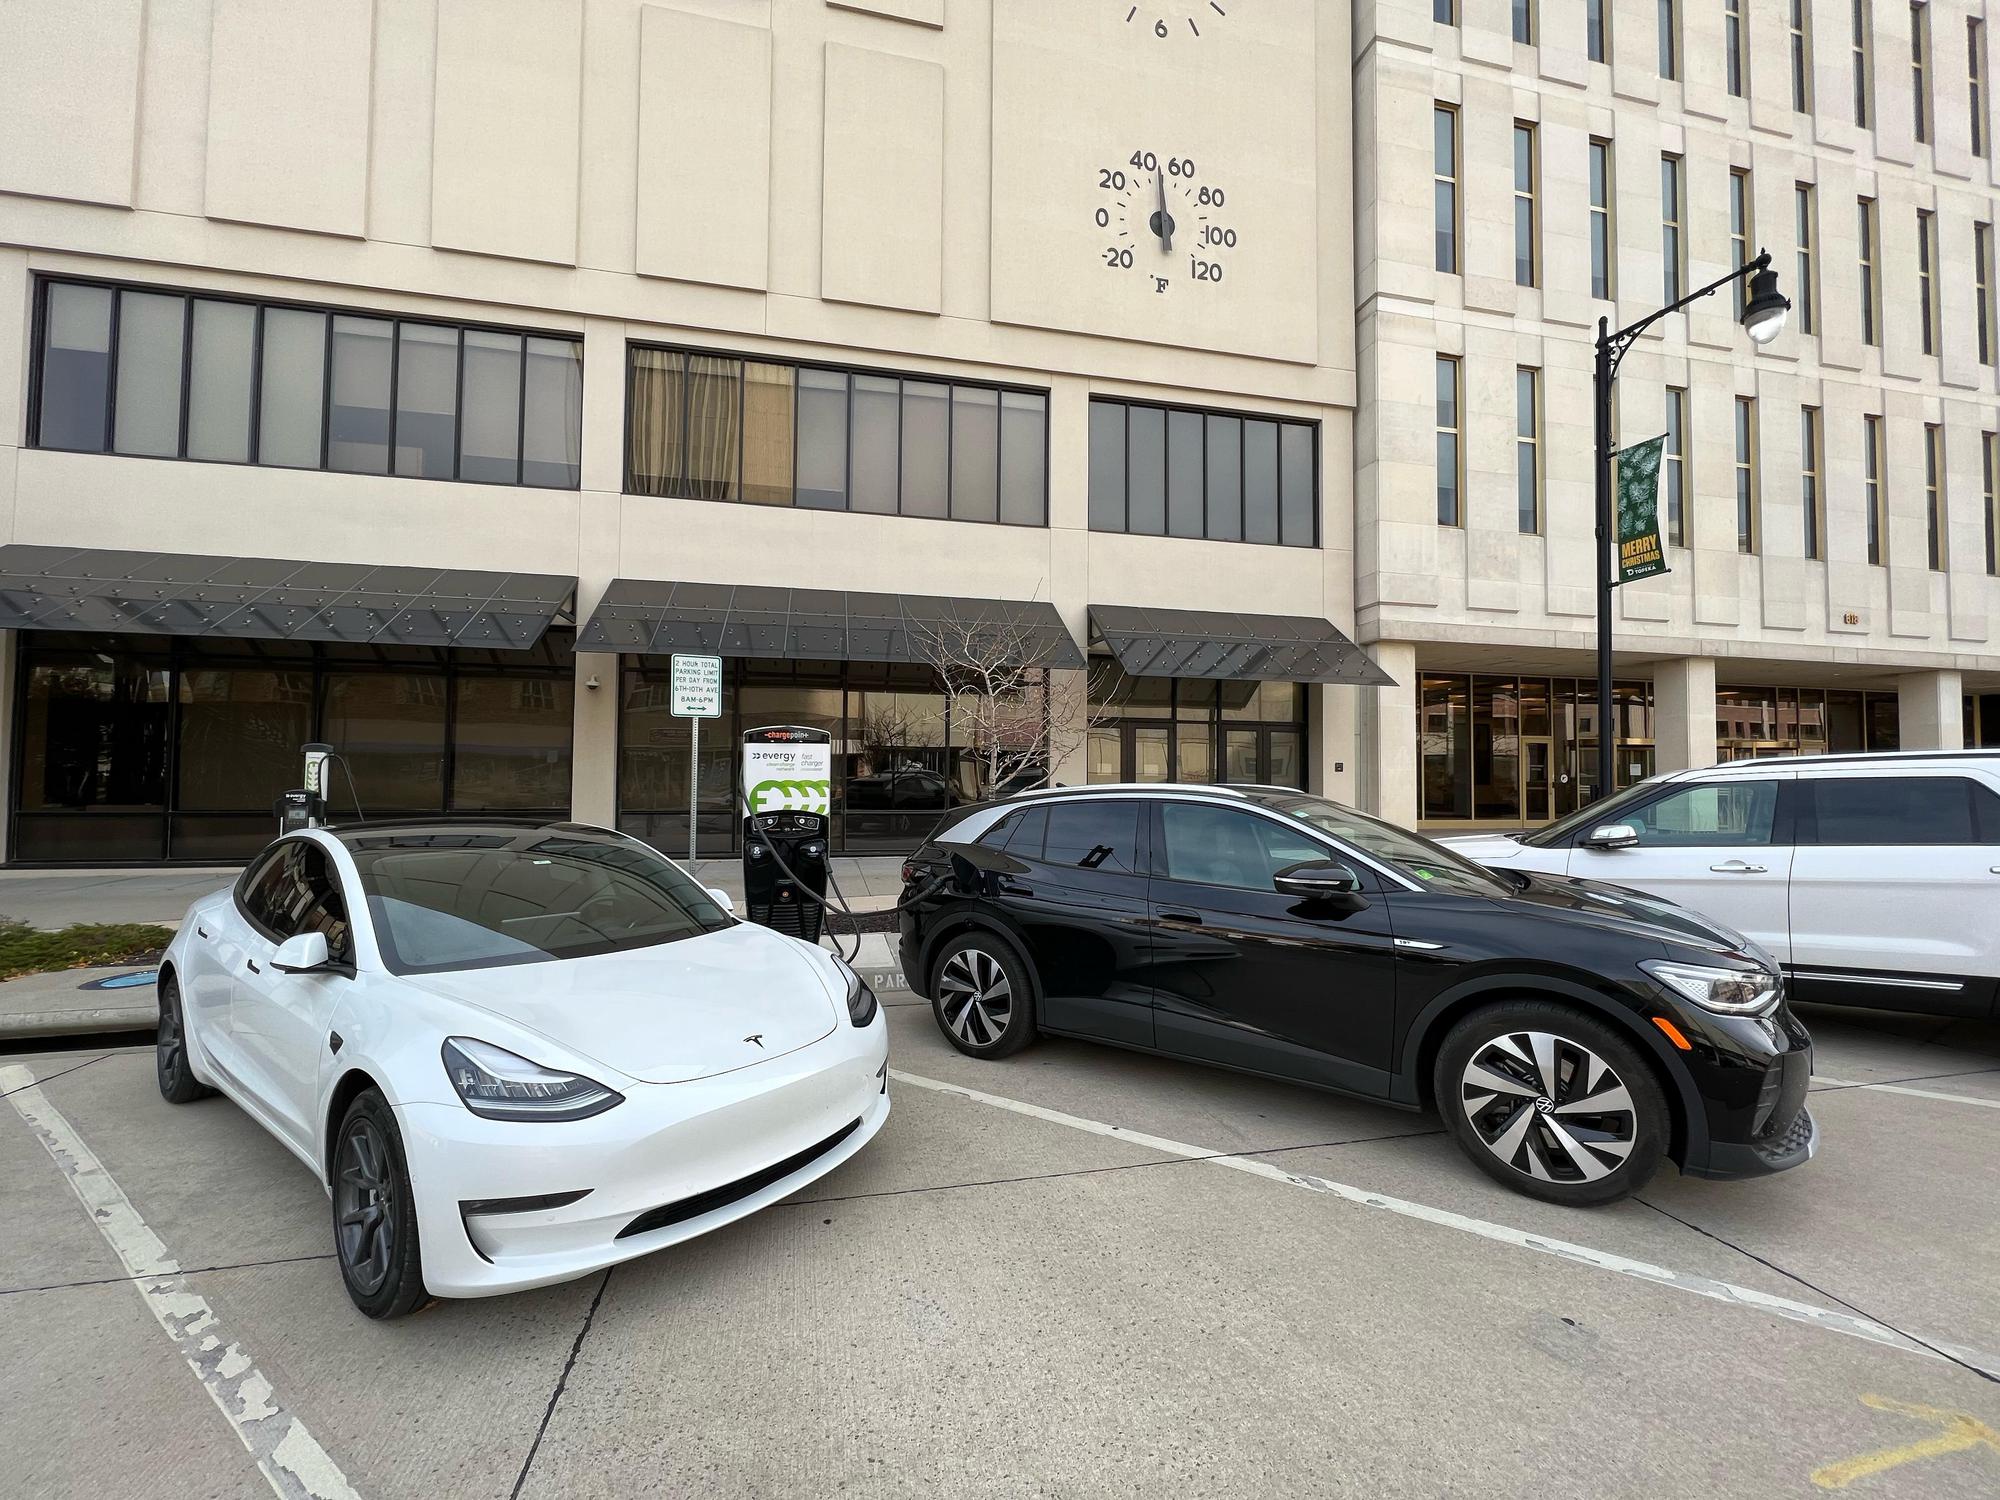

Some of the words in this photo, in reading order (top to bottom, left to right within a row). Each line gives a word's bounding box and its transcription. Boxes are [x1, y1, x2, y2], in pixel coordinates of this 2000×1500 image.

[1155, 19, 1168, 38] 6
[1129, 150, 1157, 172] 40
[1168, 157, 1195, 179] 60
[1098, 168, 1126, 191] 20
[1198, 186, 1225, 208] 80
[1095, 207, 1109, 228] 0
[1205, 225, 1237, 248] 100
[1102, 247, 1134, 269] -20
[1191, 259, 1223, 282] 120
[1621, 534, 1657, 559] MERRY
[1621, 550, 1661, 569] CHRISTMAS
[762, 752, 796, 762] evergy
[800, 760, 824, 768] charger
[801, 752, 814, 760] fast
